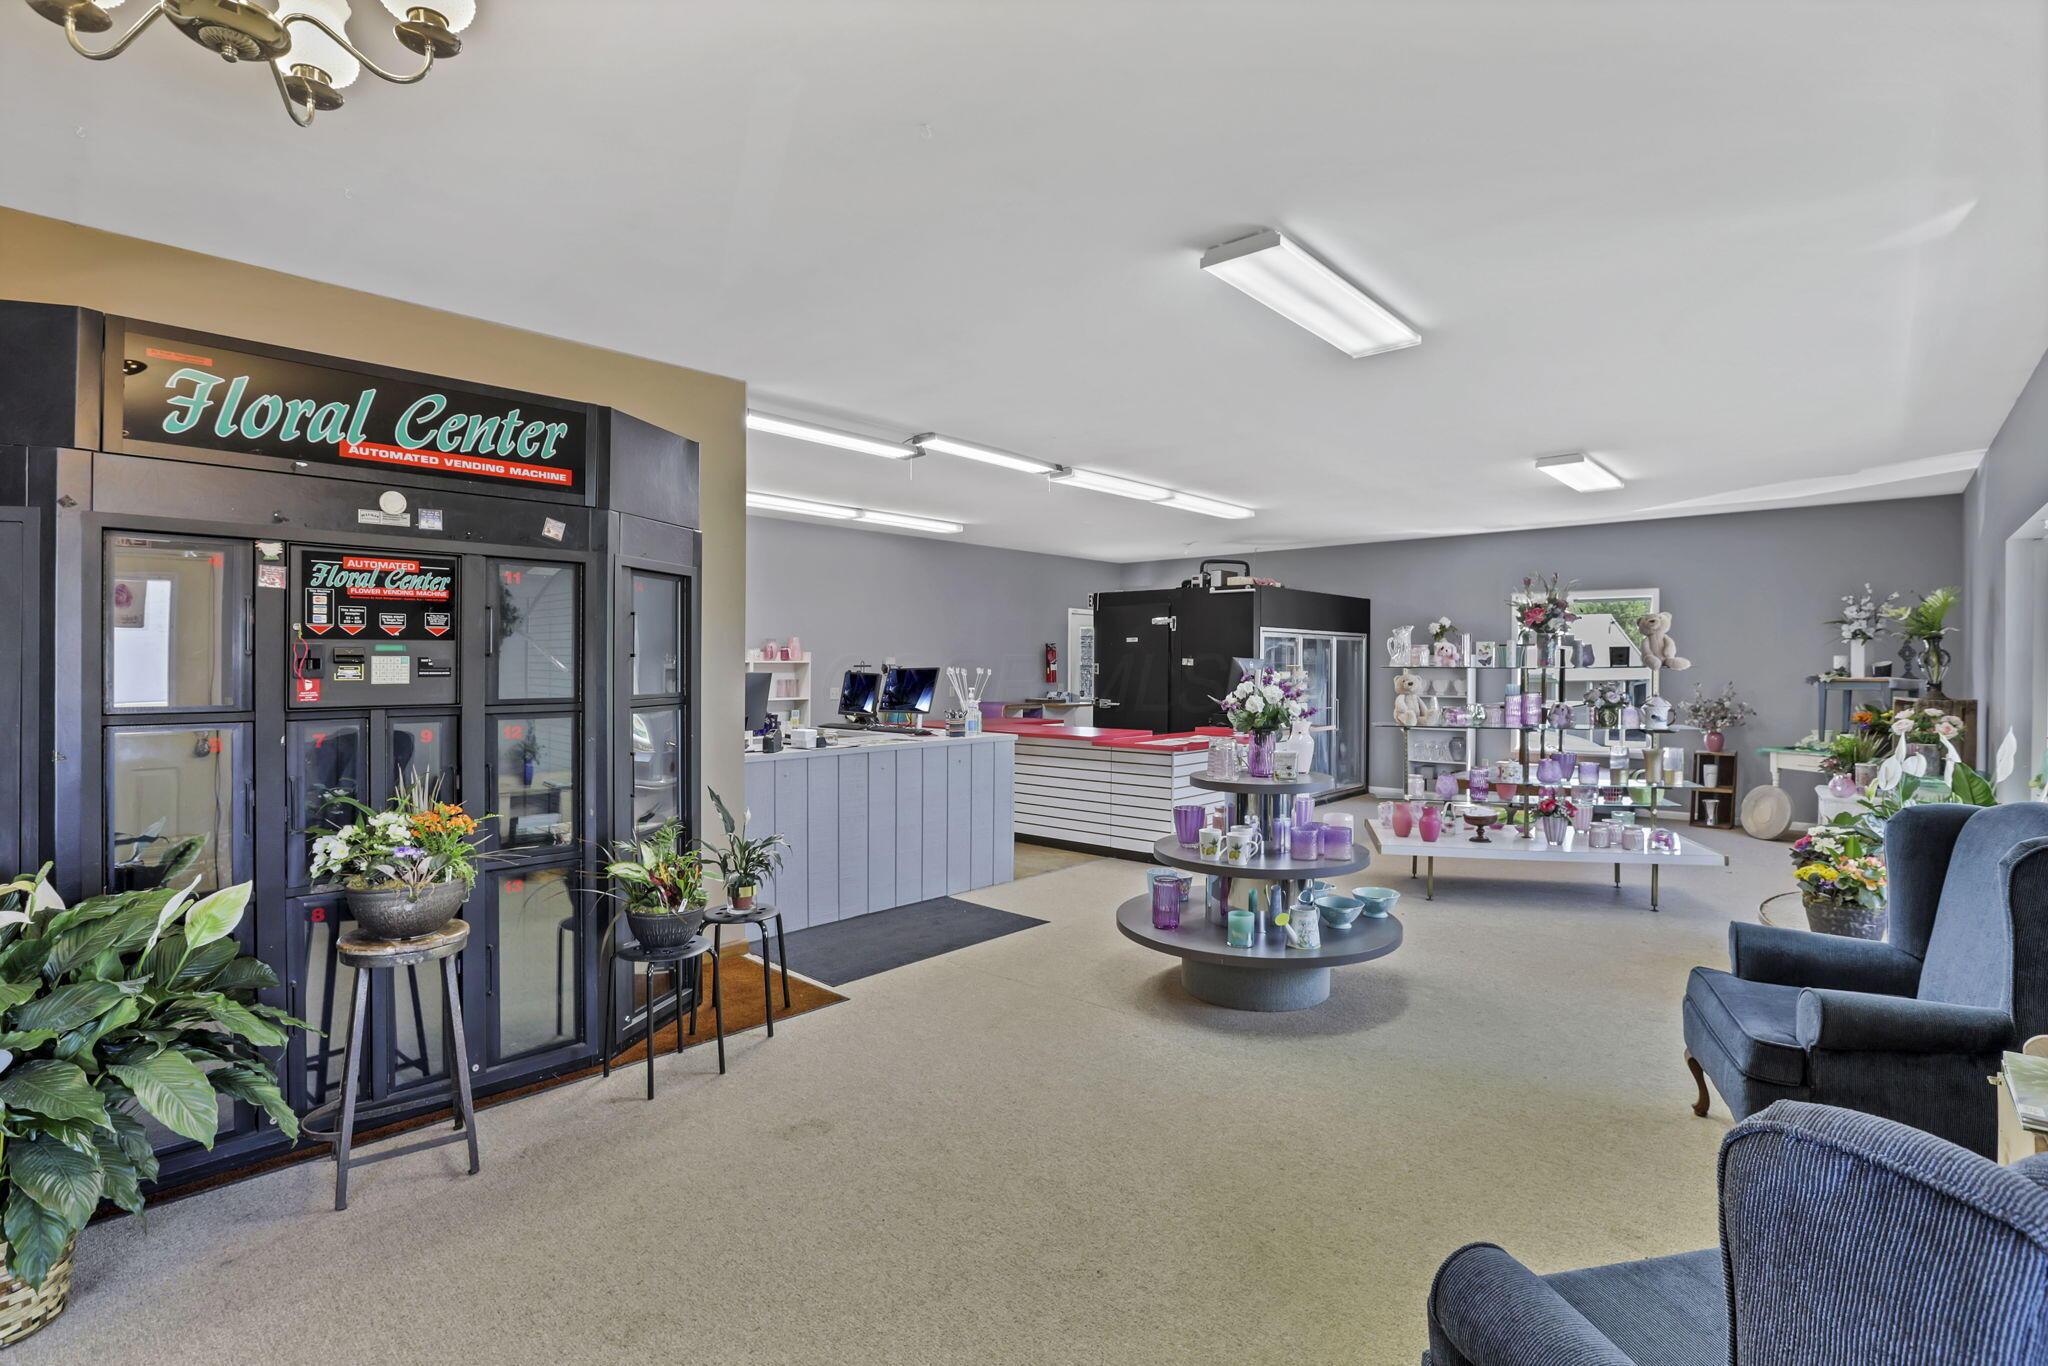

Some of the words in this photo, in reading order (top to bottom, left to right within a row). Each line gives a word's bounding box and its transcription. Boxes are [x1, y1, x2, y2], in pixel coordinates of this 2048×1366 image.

[162, 367, 376, 445] Floral
[394, 392, 568, 459] Center
[348, 445, 439, 466] AUTOMATED
[444, 457, 505, 474] VENDING
[509, 466, 568, 482] MACHINE
[346, 559, 416, 571] AUTOMATED
[310, 563, 379, 587] Floral
[384, 568, 451, 591] Center
[503, 571, 522, 585] 11
[312, 732, 328, 748] 7
[420, 728, 433, 743] 9
[503, 725, 525, 740] 12
[310, 908, 327, 922] 8
